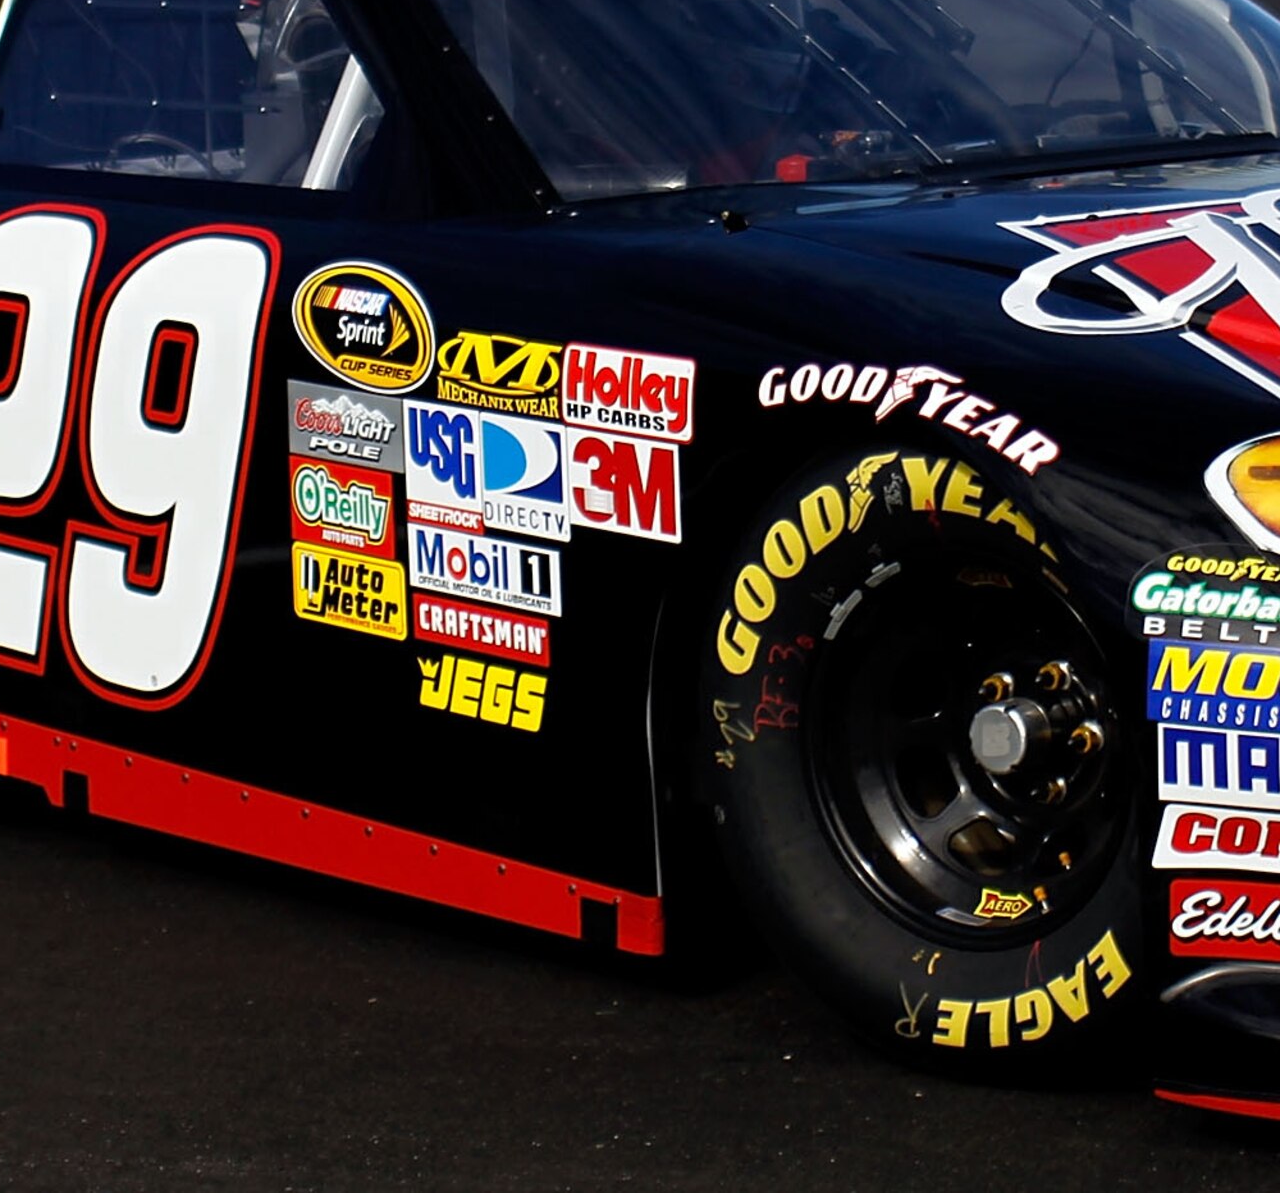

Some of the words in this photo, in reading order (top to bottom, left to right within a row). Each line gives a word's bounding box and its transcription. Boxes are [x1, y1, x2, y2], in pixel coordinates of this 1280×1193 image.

[337, 288, 390, 316] NASCAR
[336, 315, 386, 347] Sprint
[340, 358, 367, 373] CUP
[367, 363, 413, 382] SERIES
[566, 348, 690, 434] Holley
[437, 376, 513, 413] MECHANIX
[515, 396, 560, 419] WEAR
[566, 403, 591, 420] HP
[597, 407, 666, 432] CARBS
[294, 397, 343, 436] Coors
[344, 414, 397, 444] LIGHT
[758, 363, 1061, 477] GOODYEAR
[309, 436, 382, 460] POLE
[409, 407, 477, 500] USG
[296, 467, 387, 540] O'Reilly
[572, 436, 679, 536] 3M
[408, 501, 482, 530] SHEETROCK
[484, 500, 566, 536] DIRECTV
[325, 557, 384, 595] Auto
[416, 530, 509, 591] Mobil
[527, 554, 541, 595] 1
[717, 452, 1060, 675] GOODYEA
[322, 584, 399, 625] Meter
[418, 575, 450, 591] OFFICIAL
[452, 582, 480, 595] MOTOR
[481, 588, 494, 599] OIL
[503, 593, 552, 611] LUBRICANTS
[419, 603, 546, 655] CRAFTSMAN
[417, 654, 549, 733] JEGS
[1161, 697, 1280, 729] CHASSIS
[984, 896, 1022, 913] AERO
[932, 929, 1132, 1049] EAGLE
